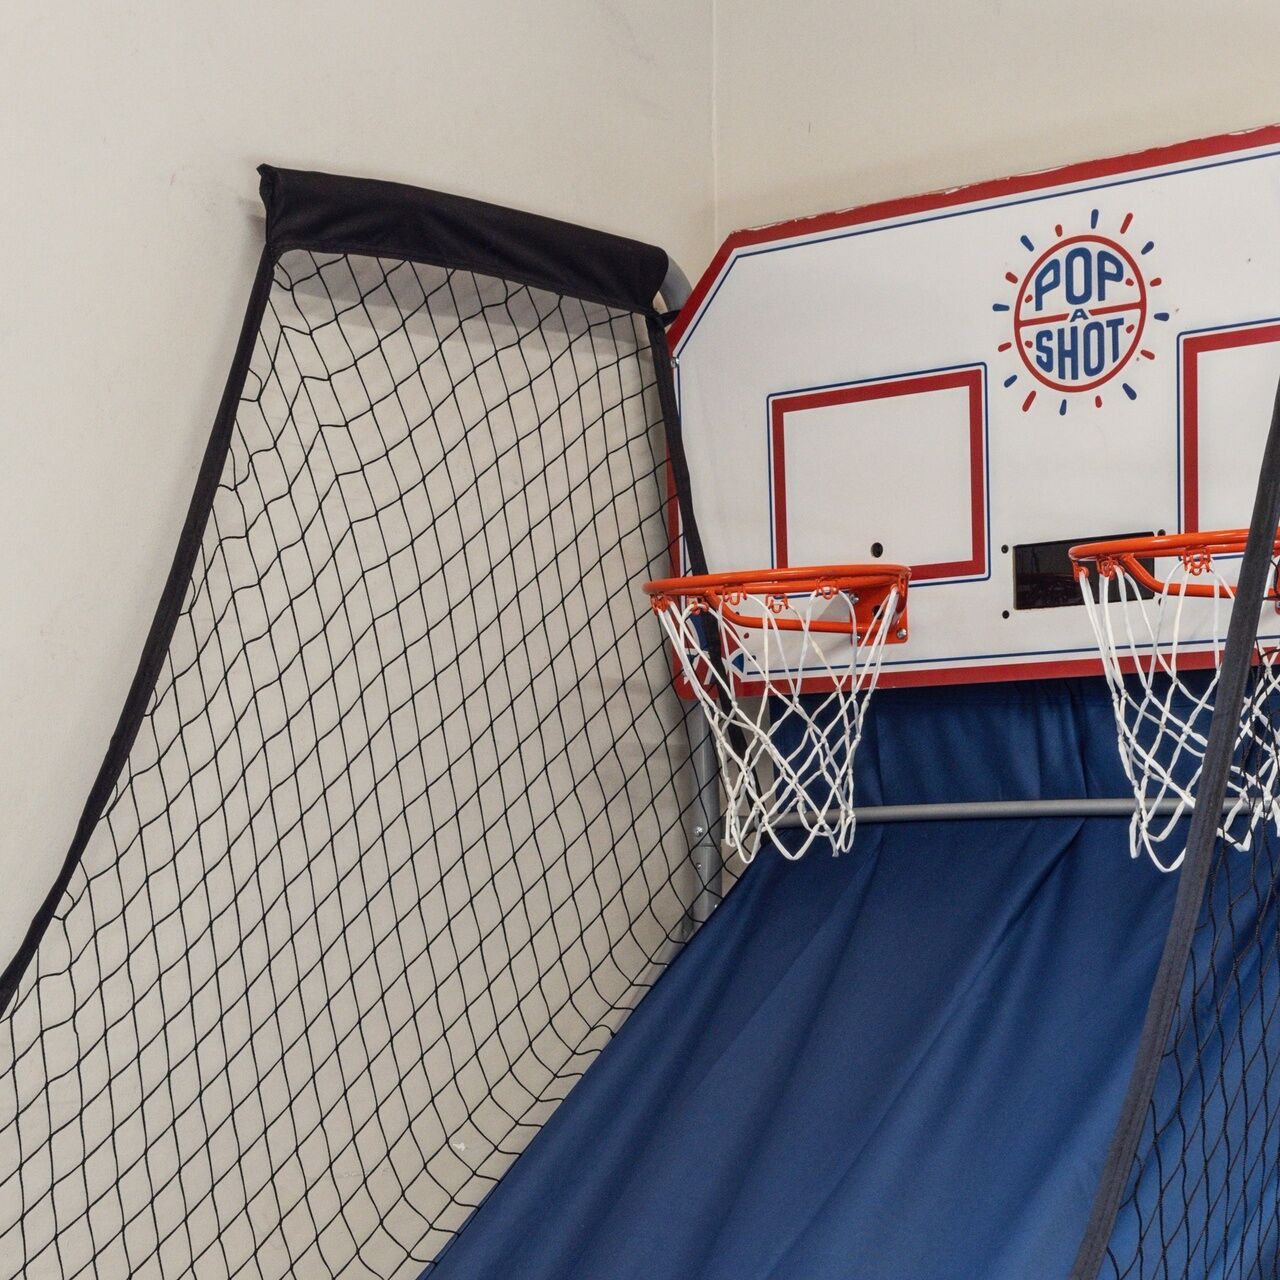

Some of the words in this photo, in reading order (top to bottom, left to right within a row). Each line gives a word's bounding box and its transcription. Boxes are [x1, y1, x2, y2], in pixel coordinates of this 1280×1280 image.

[1034, 247, 1124, 312] POP
[1070, 308, 1089, 323] A
[1035, 317, 1125, 381] SHOT
